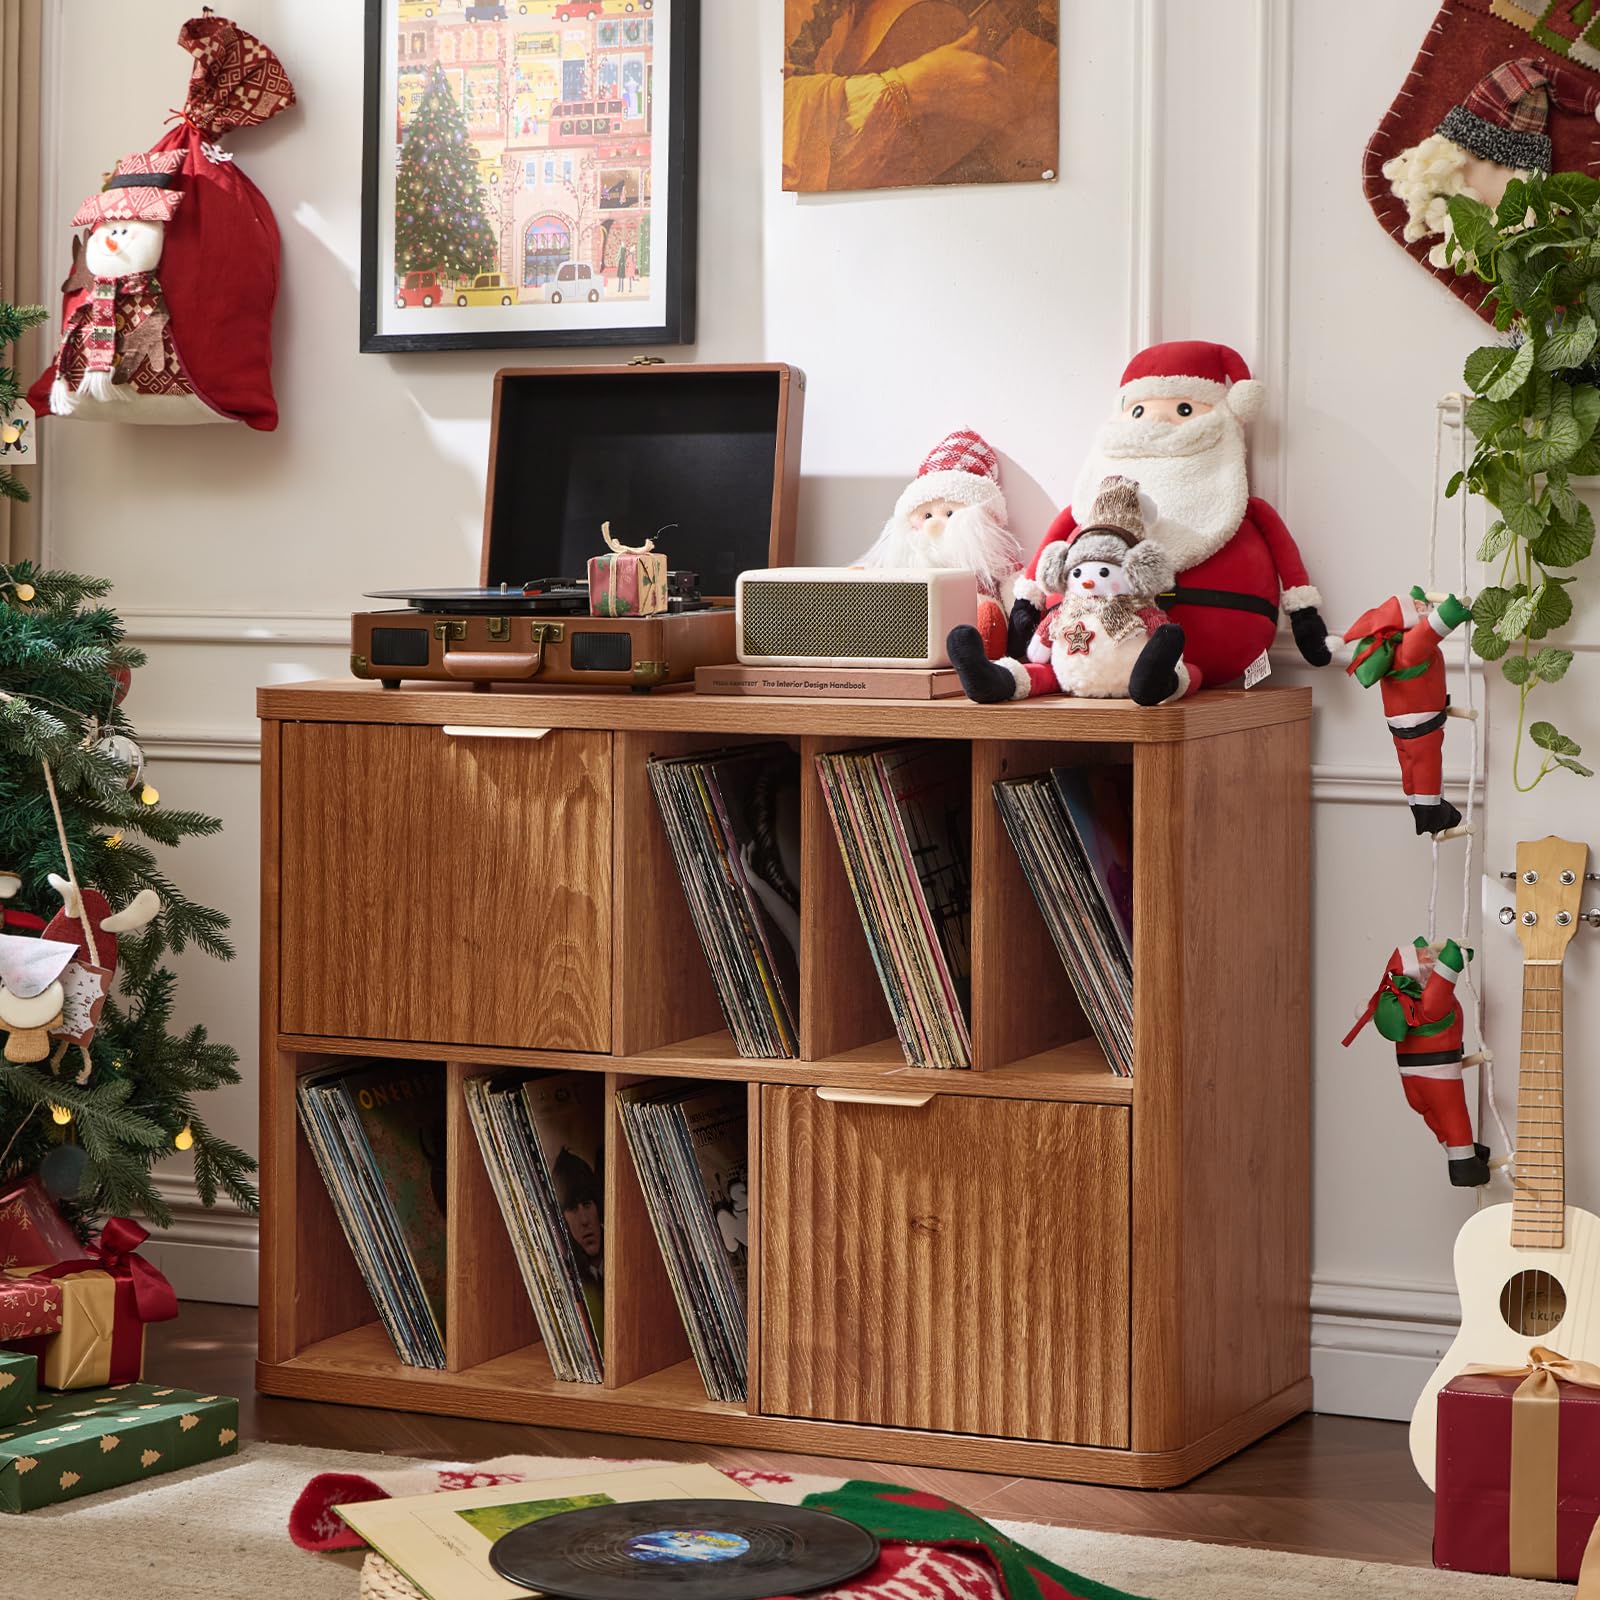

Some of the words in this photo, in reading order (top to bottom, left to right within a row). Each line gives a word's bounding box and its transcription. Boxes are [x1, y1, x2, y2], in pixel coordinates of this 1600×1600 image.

[762, 680, 775, 688] The
[776, 680, 802, 689] Interior
[804, 681, 828, 691] Design
[829, 682, 866, 690] Handbook
